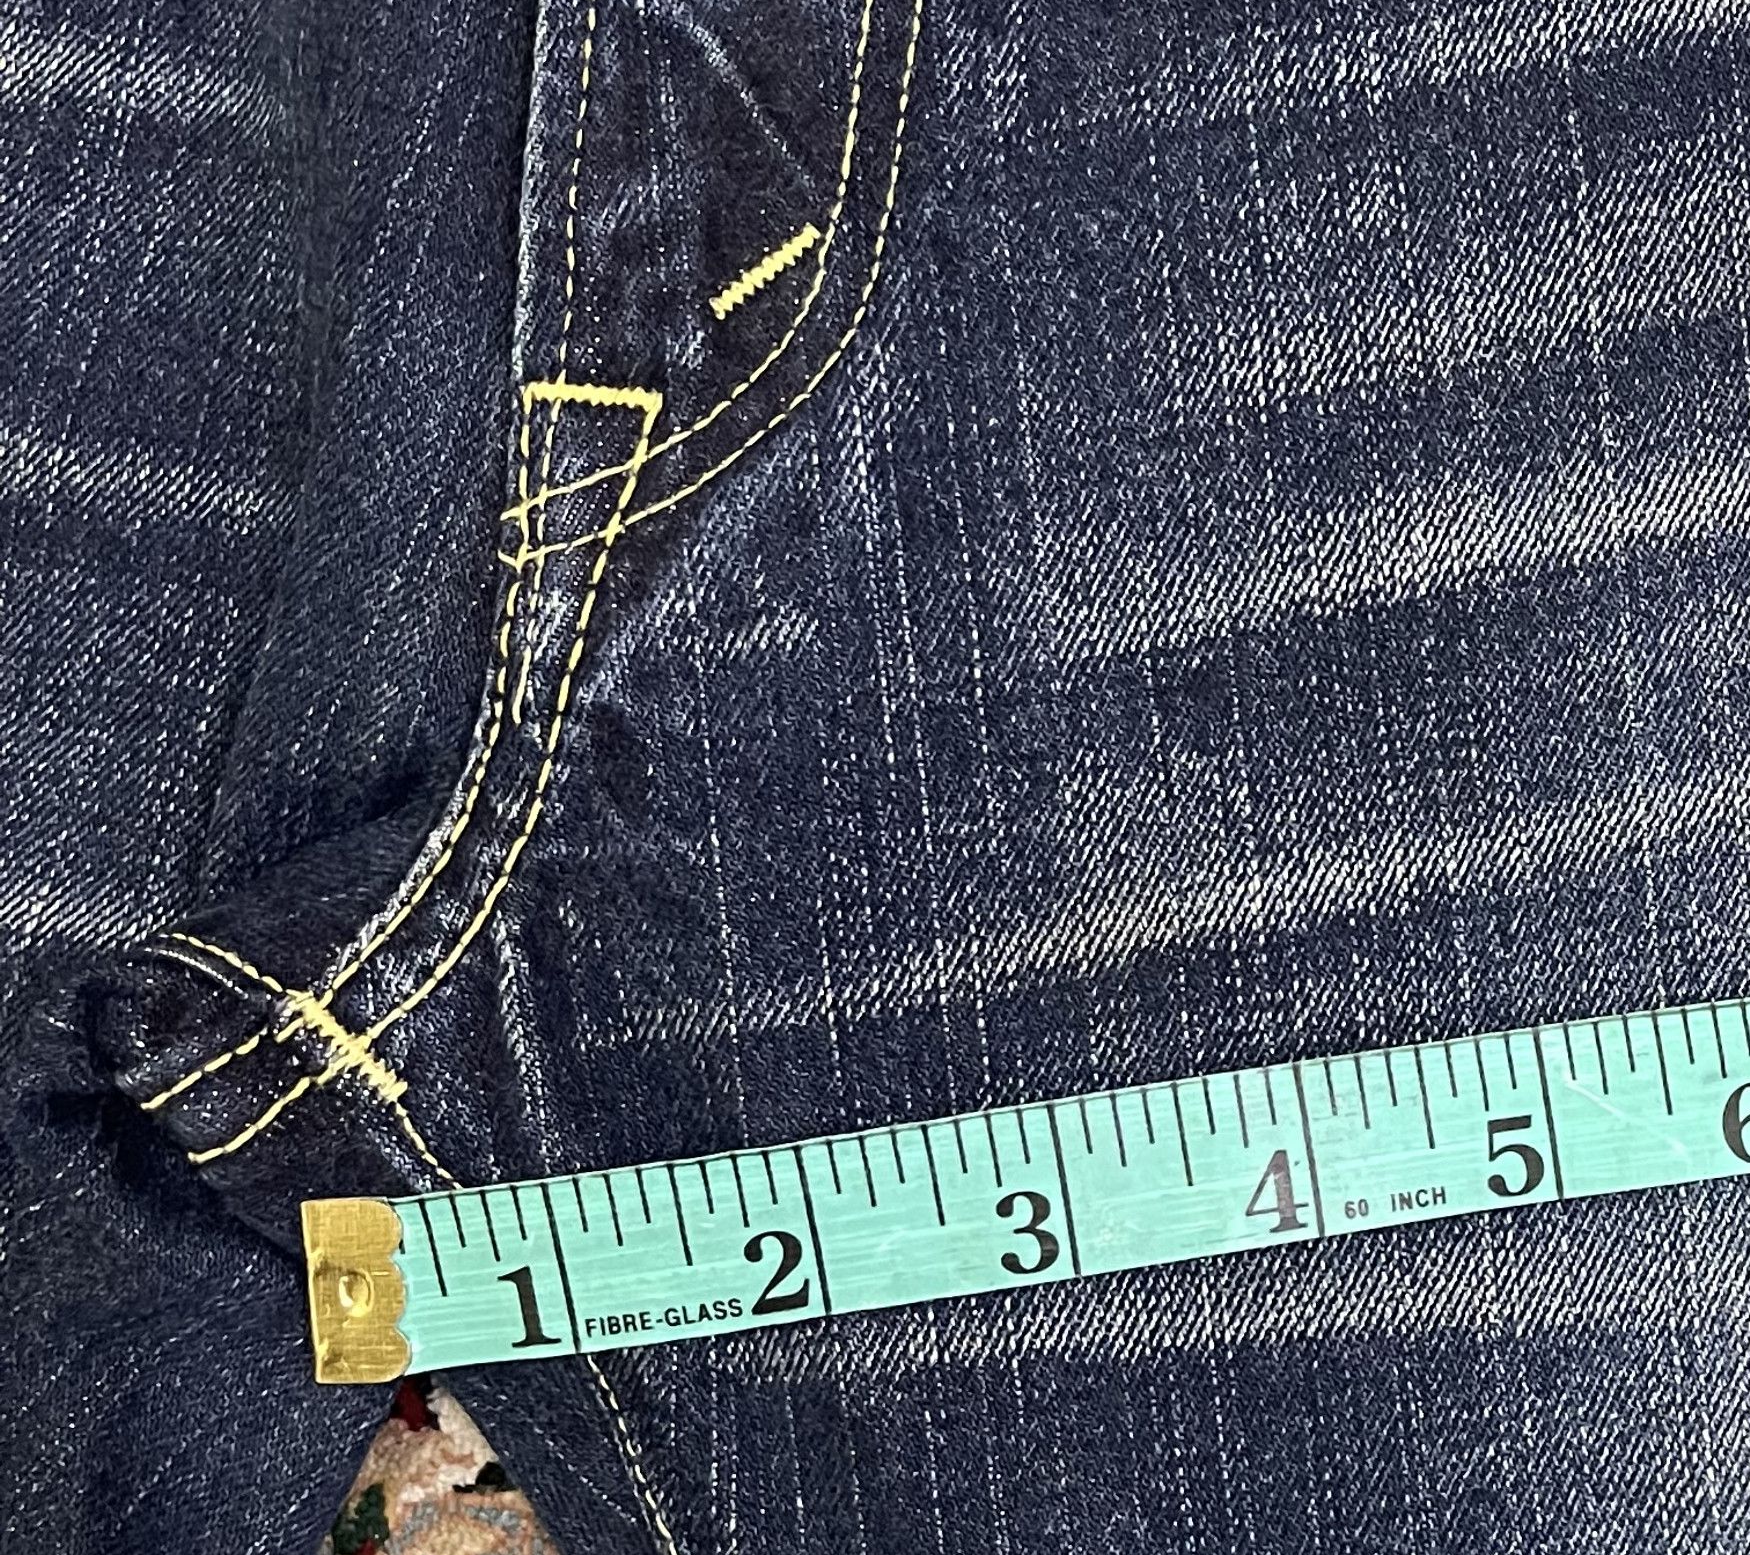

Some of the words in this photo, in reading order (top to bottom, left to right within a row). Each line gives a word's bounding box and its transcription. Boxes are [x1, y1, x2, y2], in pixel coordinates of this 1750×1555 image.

[1344, 1198, 1370, 1219] 60
[1390, 1186, 1447, 1213] INCH
[497, 1266, 561, 1349] 1
[743, 1230, 810, 1316] 2
[996, 1190, 1061, 1275] 3
[1245, 1149, 1308, 1234] 4
[1487, 1115, 1545, 1198] 5
[584, 1298, 744, 1339] FIBRE-GLASS
